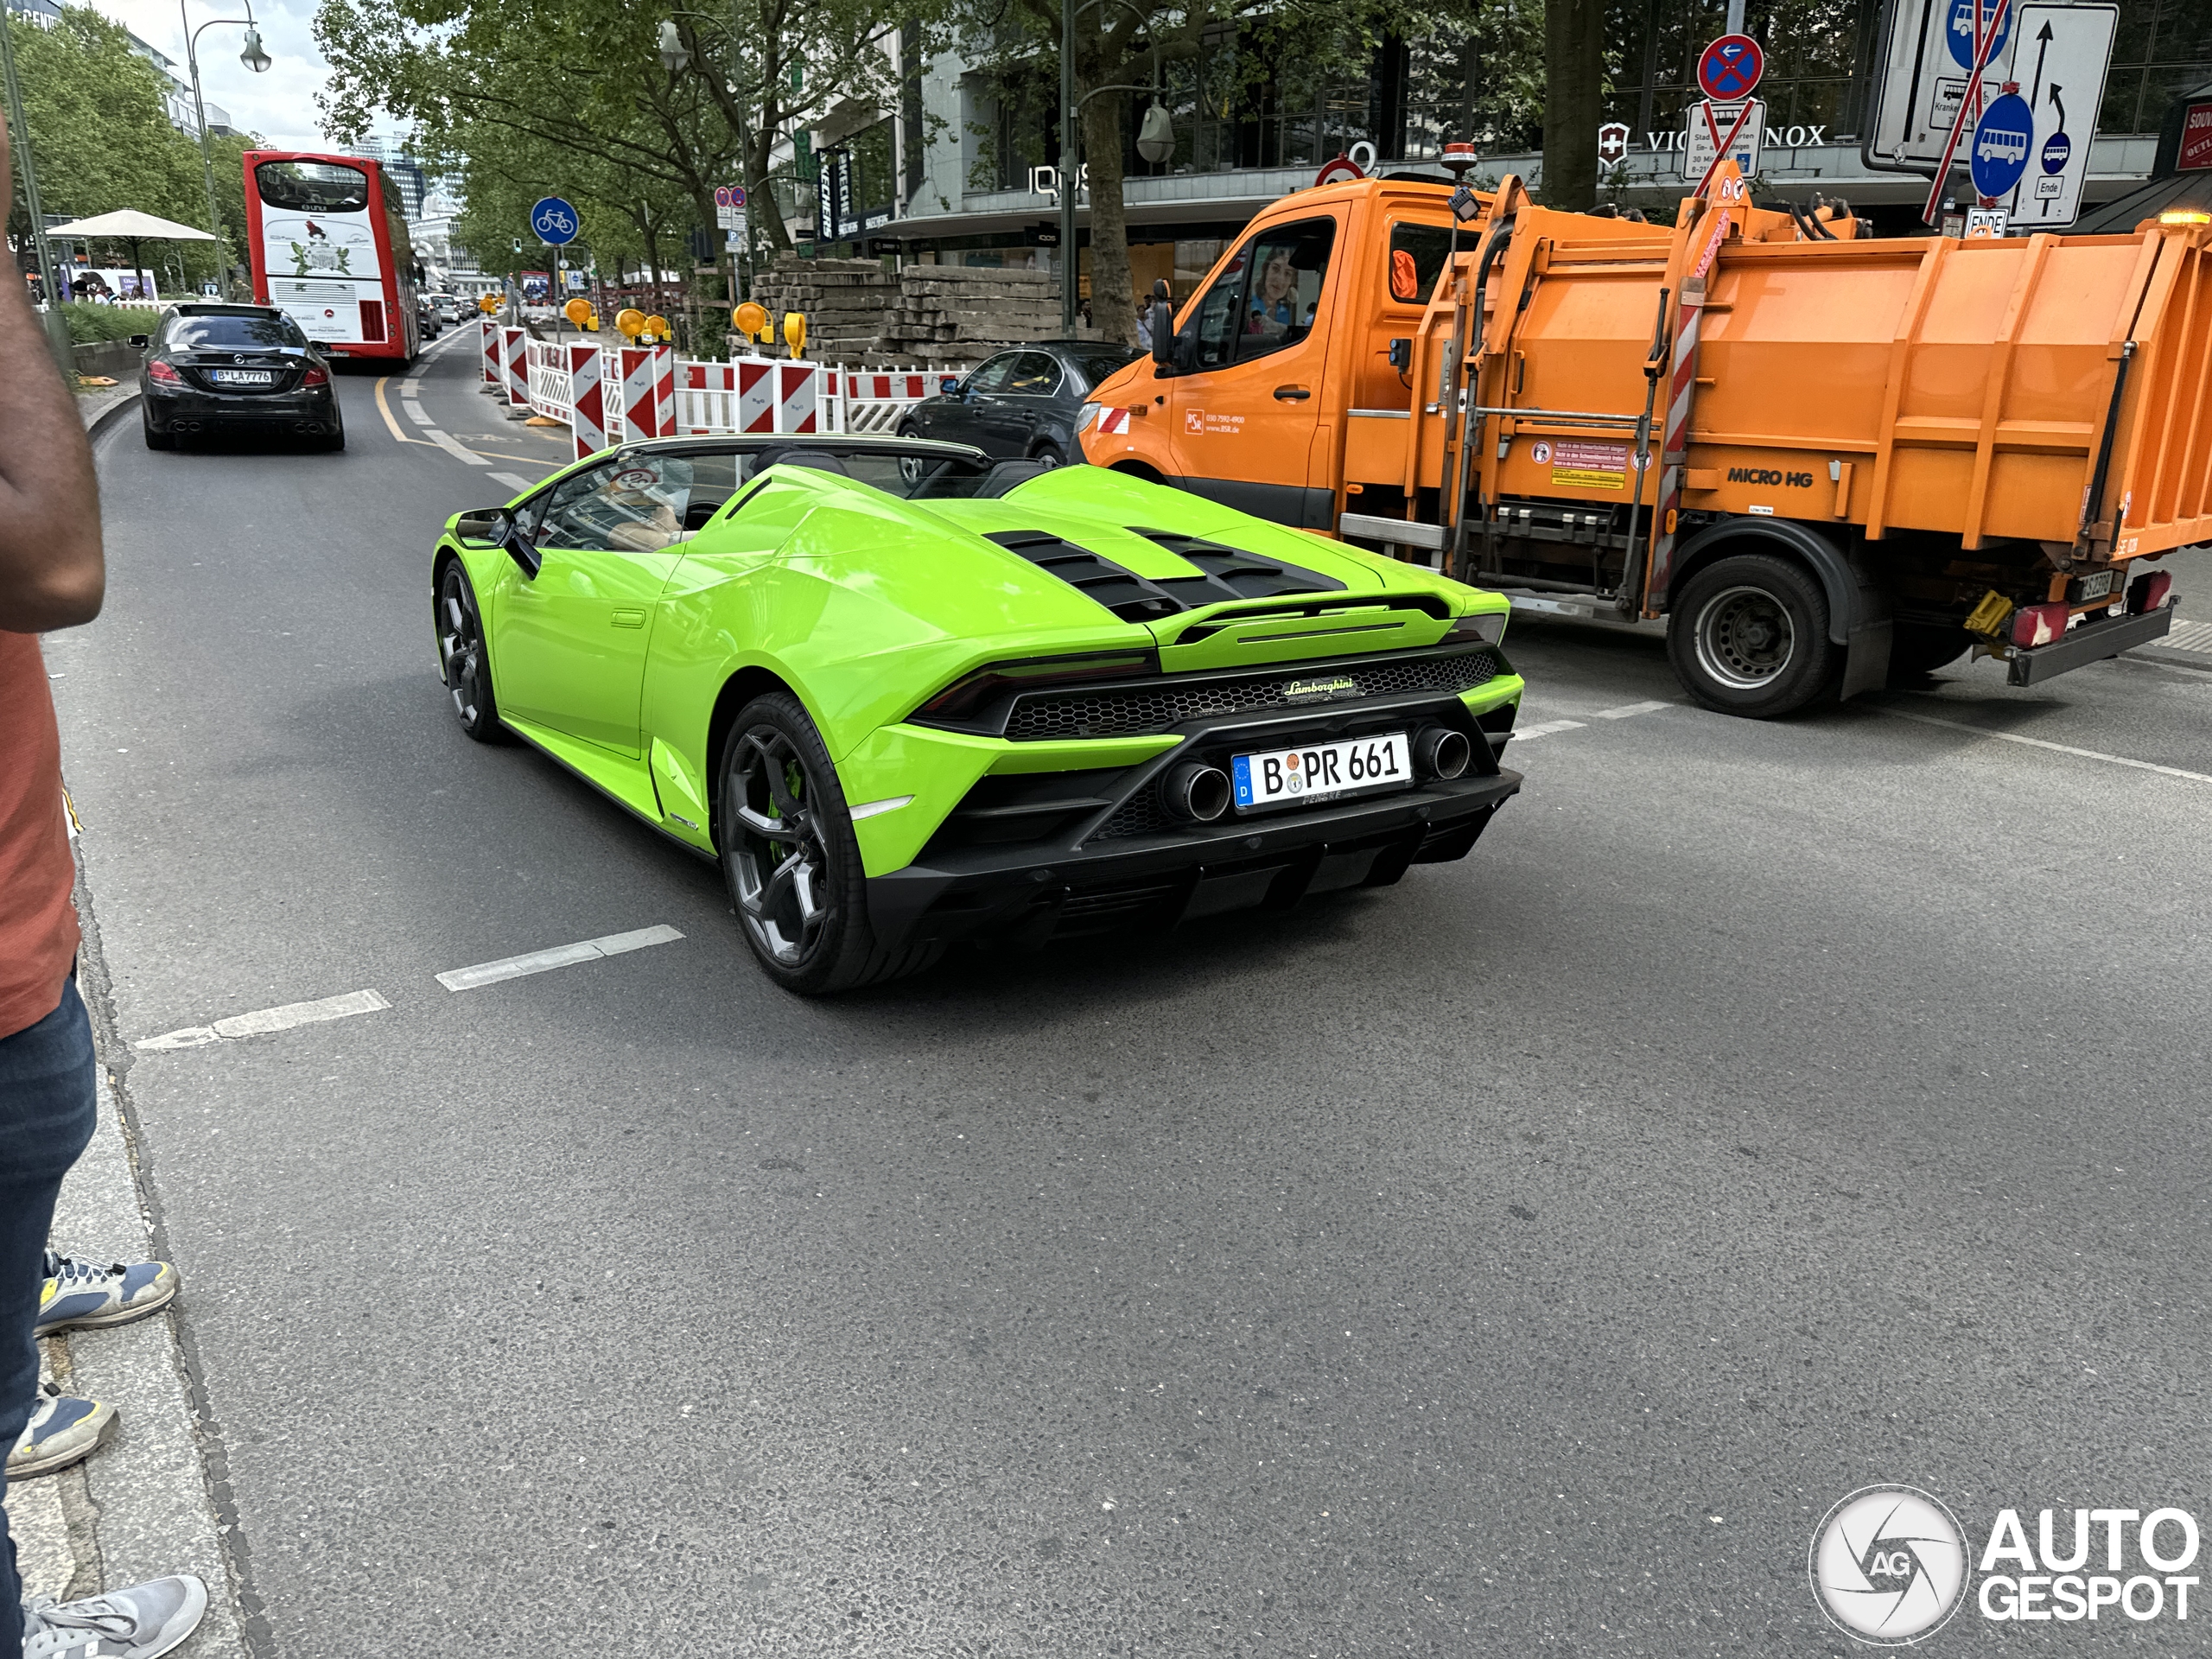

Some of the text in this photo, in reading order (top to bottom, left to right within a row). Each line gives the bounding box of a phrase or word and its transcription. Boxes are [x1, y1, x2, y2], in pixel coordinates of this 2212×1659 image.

[2189, 111, 2212, 129] SOUV
[2187, 137, 2212, 157] OUTL
[2040, 182, 2058, 193] Ende
[218, 371, 225, 380] B
[1187, 413, 1202, 430] BSR
[1727, 467, 1813, 488] MICRO HG
[1284, 677, 1354, 696] Lamborghini
[1240, 741, 1399, 798] D B PR 661
[1302, 791, 1342, 805] PENSKE
